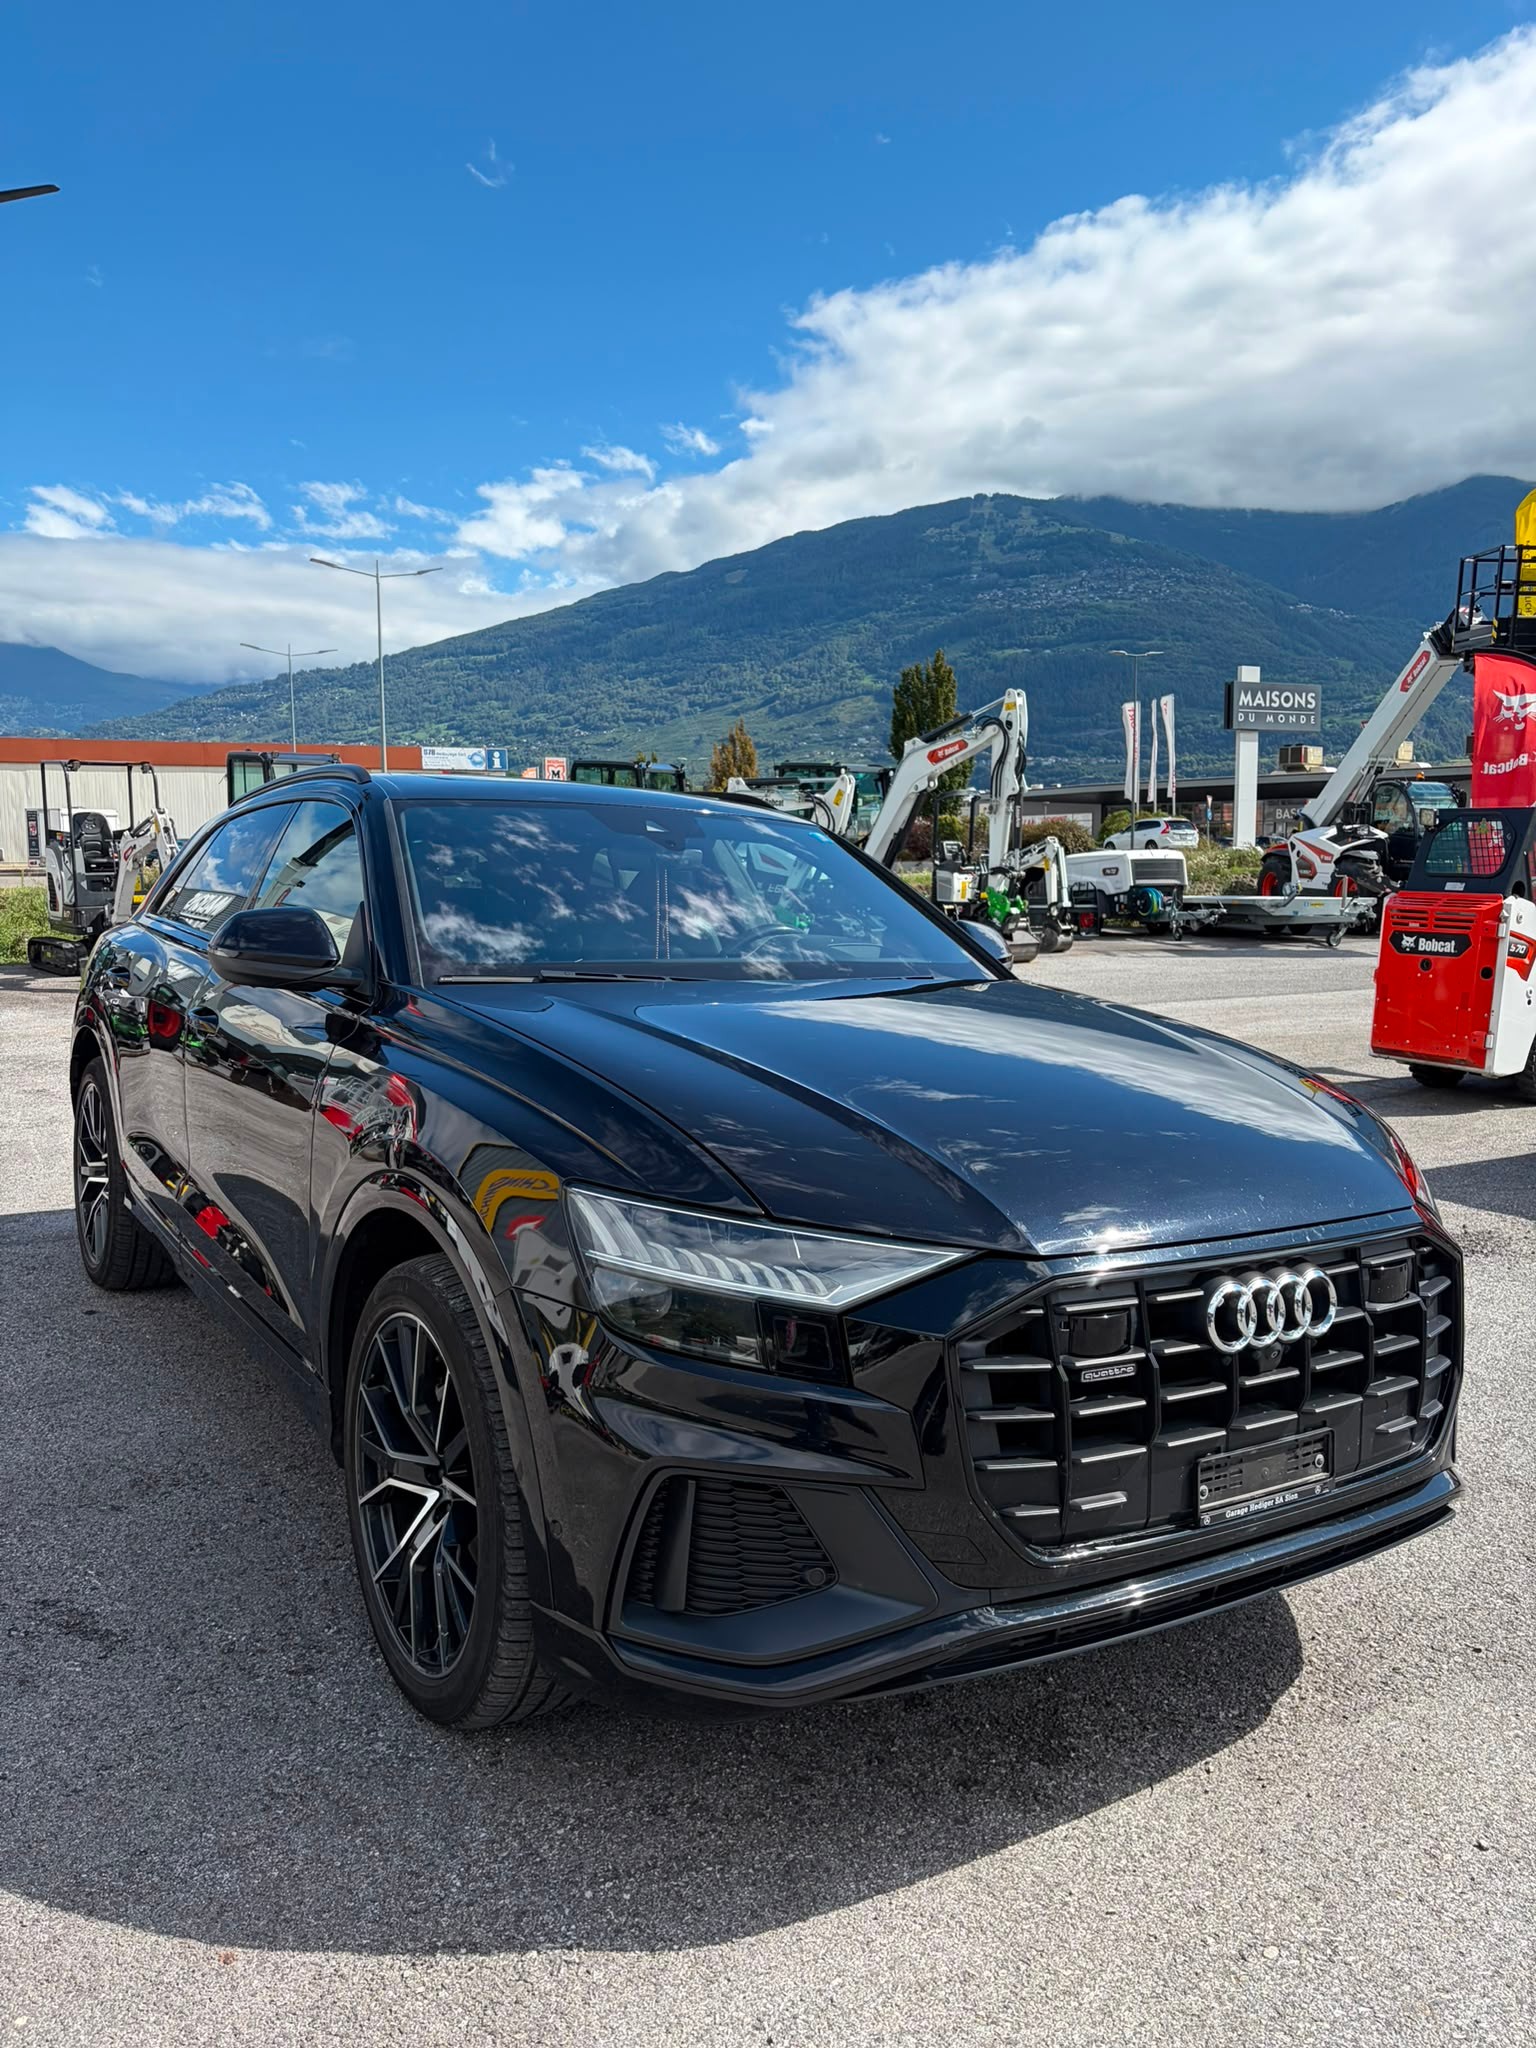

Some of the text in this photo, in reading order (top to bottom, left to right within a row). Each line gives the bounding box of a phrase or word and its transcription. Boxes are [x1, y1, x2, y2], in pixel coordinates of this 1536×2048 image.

[1238, 690, 1316, 709] MAISONS
[1238, 712, 1316, 725] DU MONDE
[1417, 937, 1456, 953] Bobcat
[1084, 1366, 1134, 1380] quattro
[1225, 1492, 1299, 1518] Garage Hediger SA Sion
